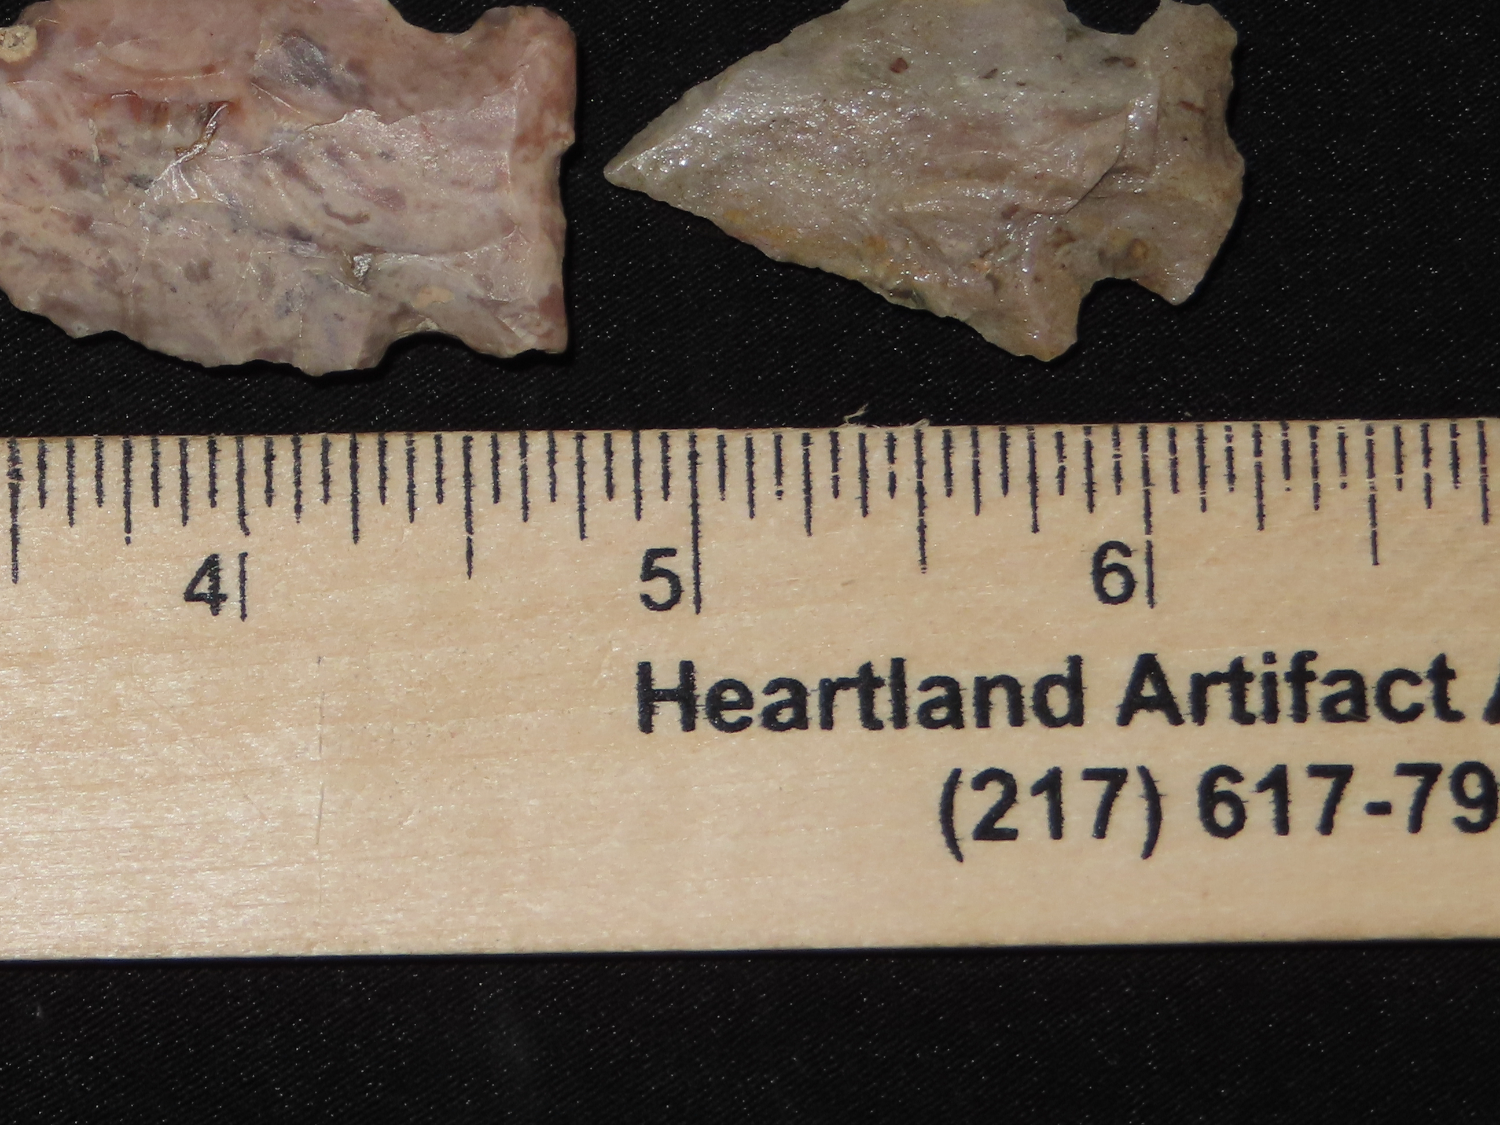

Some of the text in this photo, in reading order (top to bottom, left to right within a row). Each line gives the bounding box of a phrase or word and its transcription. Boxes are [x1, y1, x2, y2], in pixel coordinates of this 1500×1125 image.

[183, 553, 228, 616] 4
[639, 547, 683, 612] 5
[1090, 541, 1137, 606] 6
[636, 655, 1085, 734] Heartland
[1117, 651, 1465, 727] Artifact
[940, 761, 1500, 863] (217) 617-79
